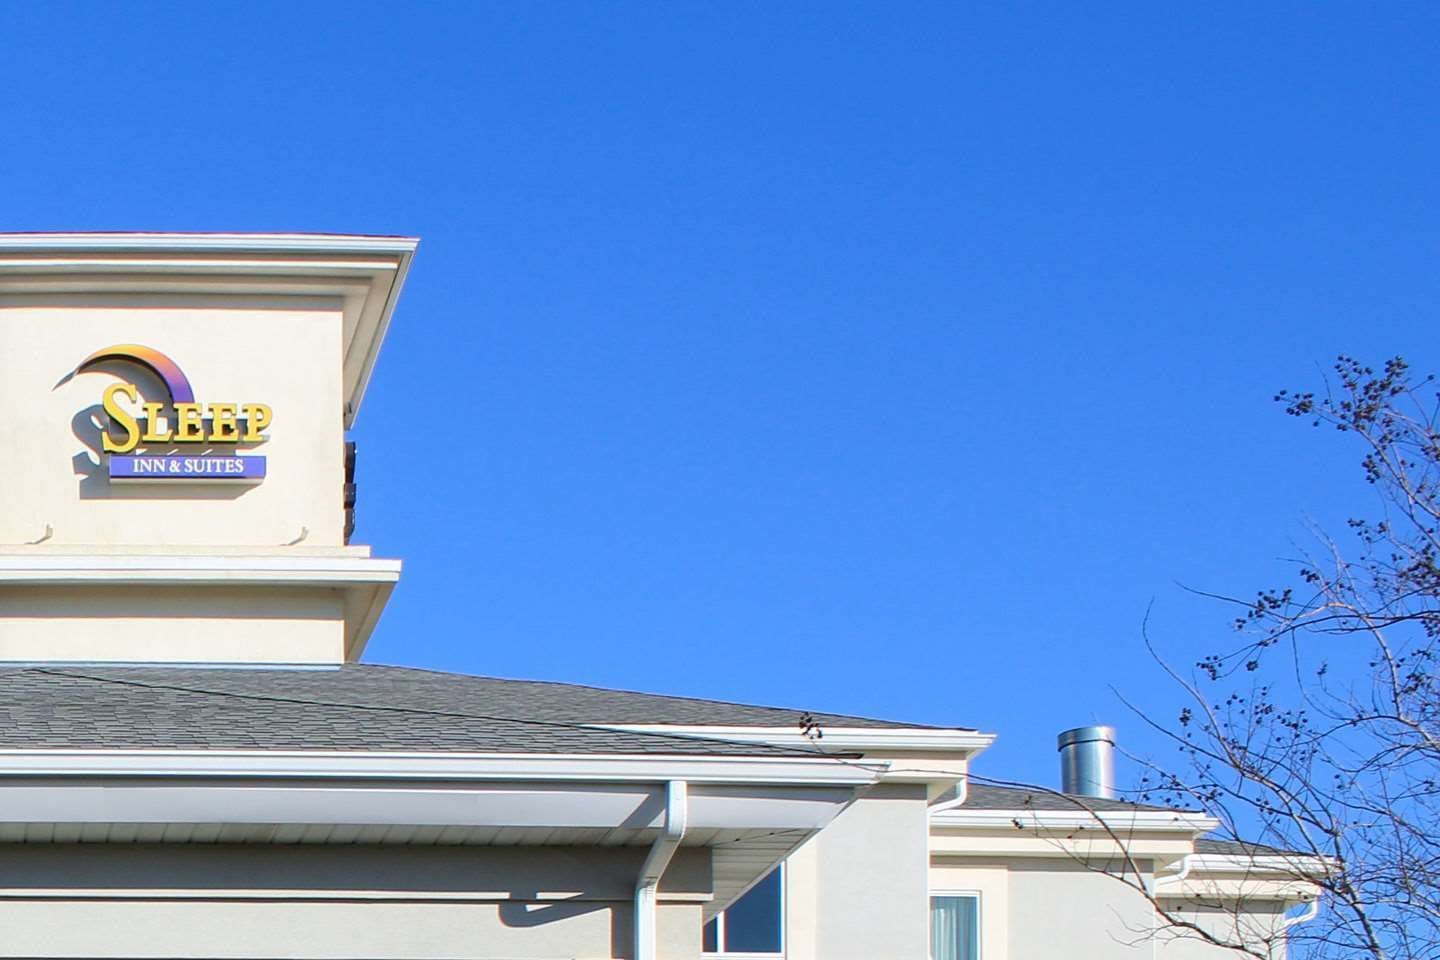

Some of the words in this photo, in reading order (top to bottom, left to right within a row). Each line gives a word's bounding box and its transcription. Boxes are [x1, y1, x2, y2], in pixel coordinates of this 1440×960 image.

[102, 383, 273, 453] SLEEP
[133, 458, 166, 473] INN
[169, 458, 181, 473] &
[184, 458, 244, 473] SUITES
